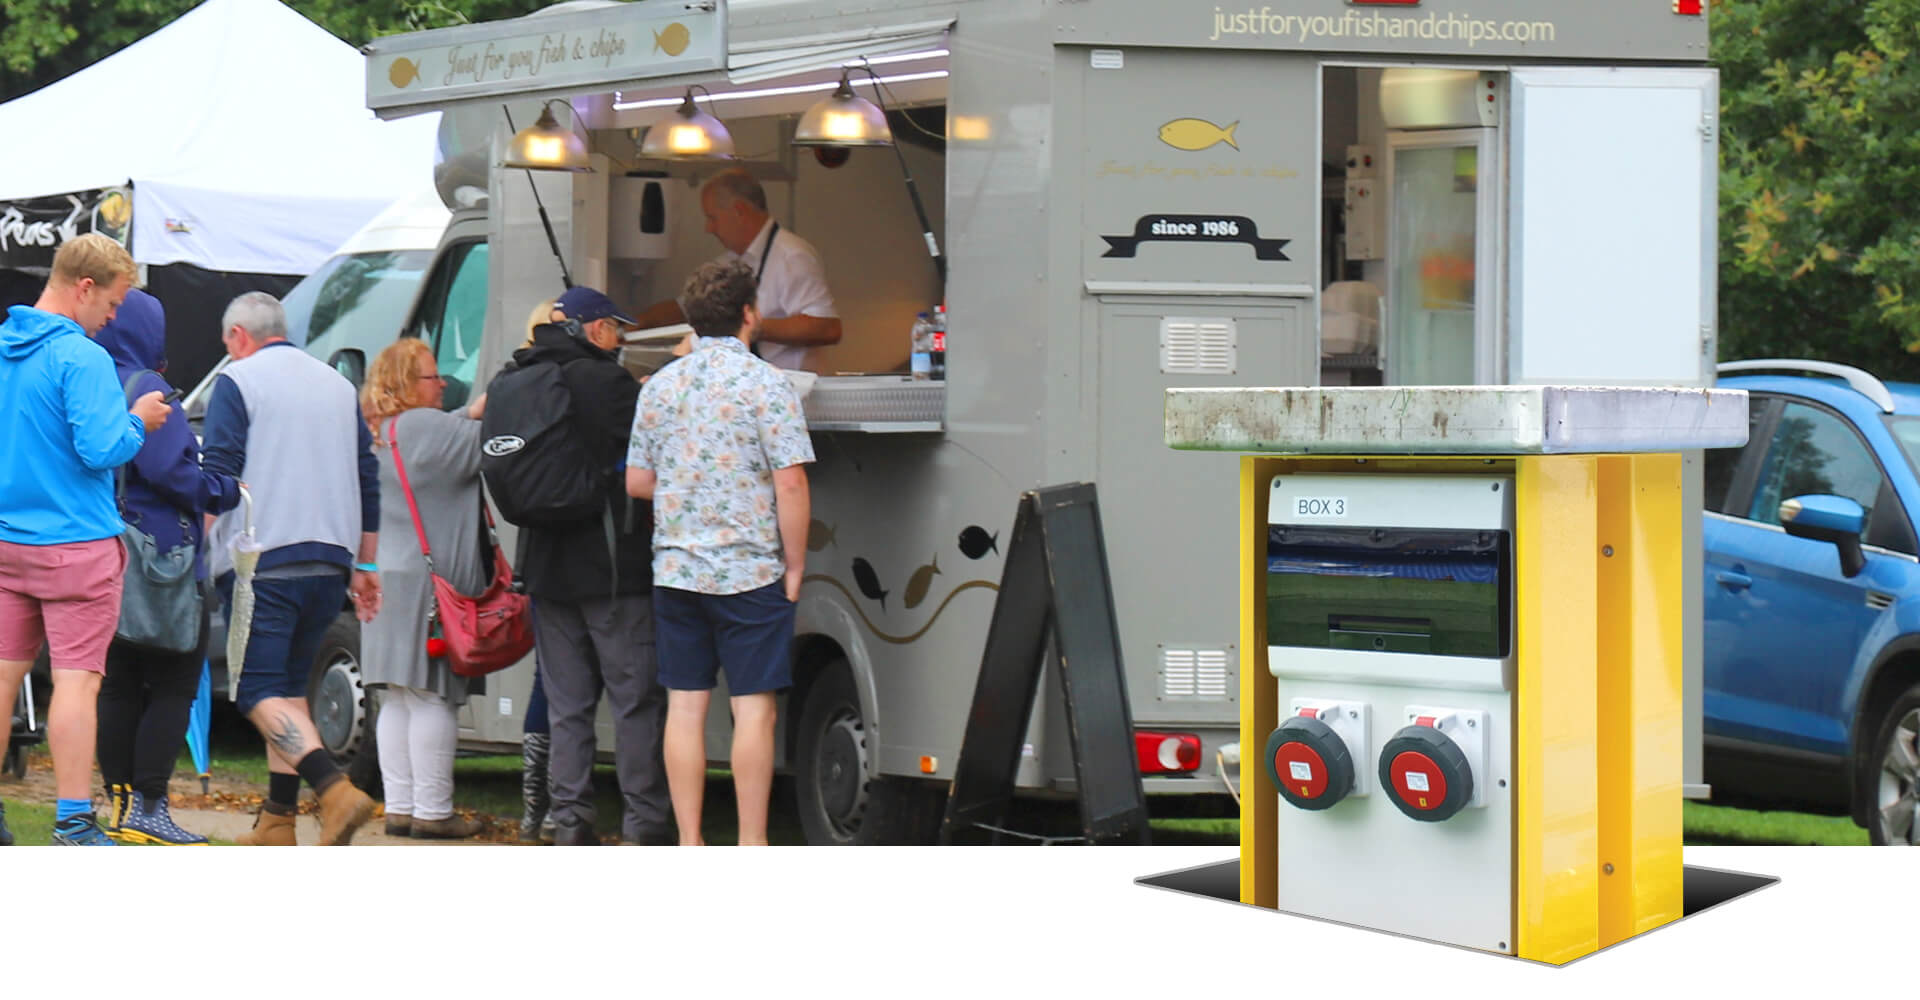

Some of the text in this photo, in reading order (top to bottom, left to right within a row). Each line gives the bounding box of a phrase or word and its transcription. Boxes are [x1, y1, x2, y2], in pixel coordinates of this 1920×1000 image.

[1209, 7, 1555, 46] justforyoufishandchips.com
[1152, 219, 1239, 236] since 1986
[1298, 499, 1345, 515] BOX 3
